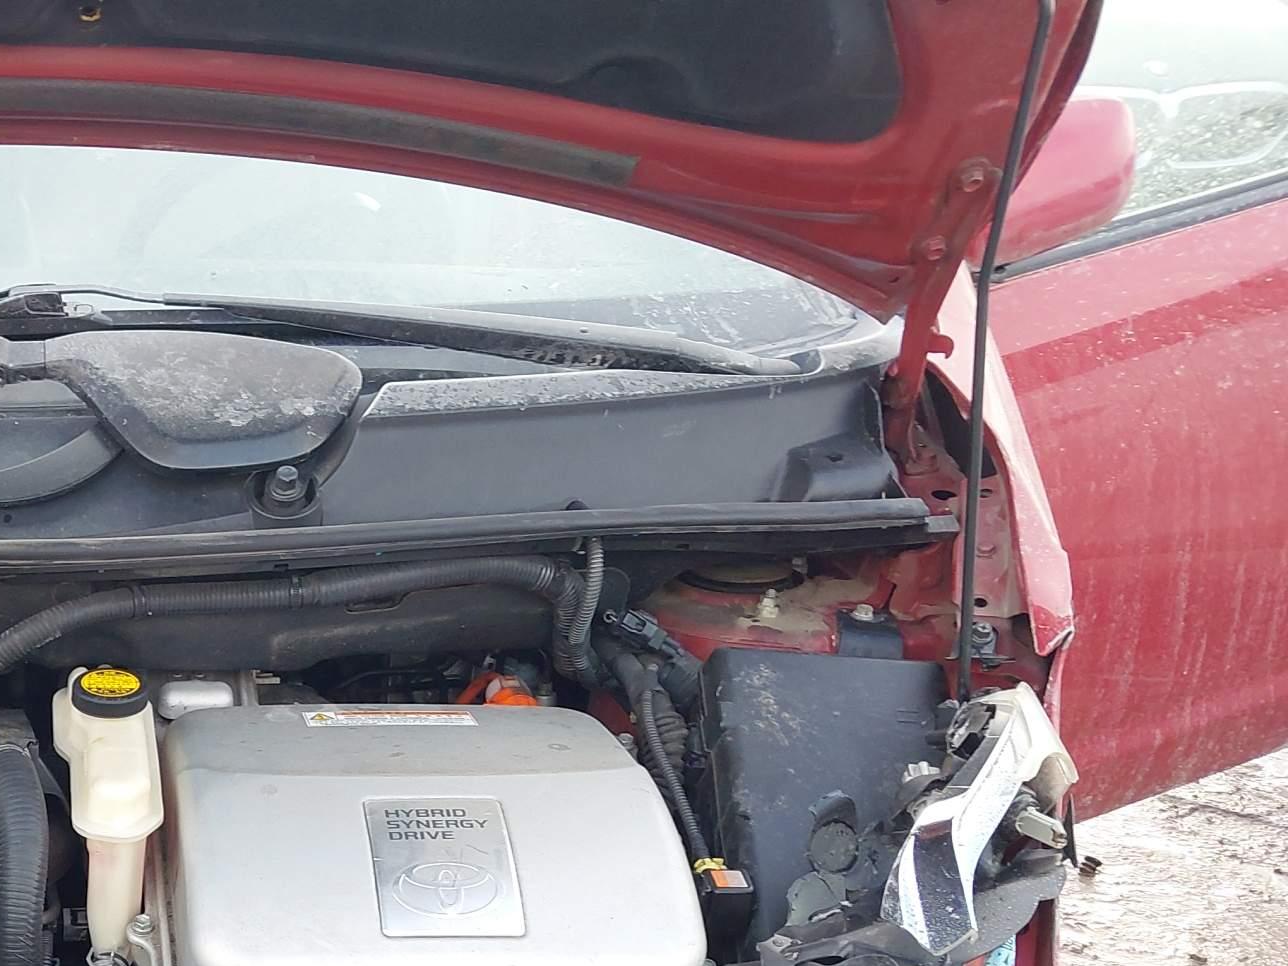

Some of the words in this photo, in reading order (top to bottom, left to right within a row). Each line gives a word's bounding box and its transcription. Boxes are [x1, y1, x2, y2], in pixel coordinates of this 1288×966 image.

[384, 808, 466, 818] HYBRID
[386, 819, 488, 829] SYNERGY
[389, 830, 456, 841] DRIVE
